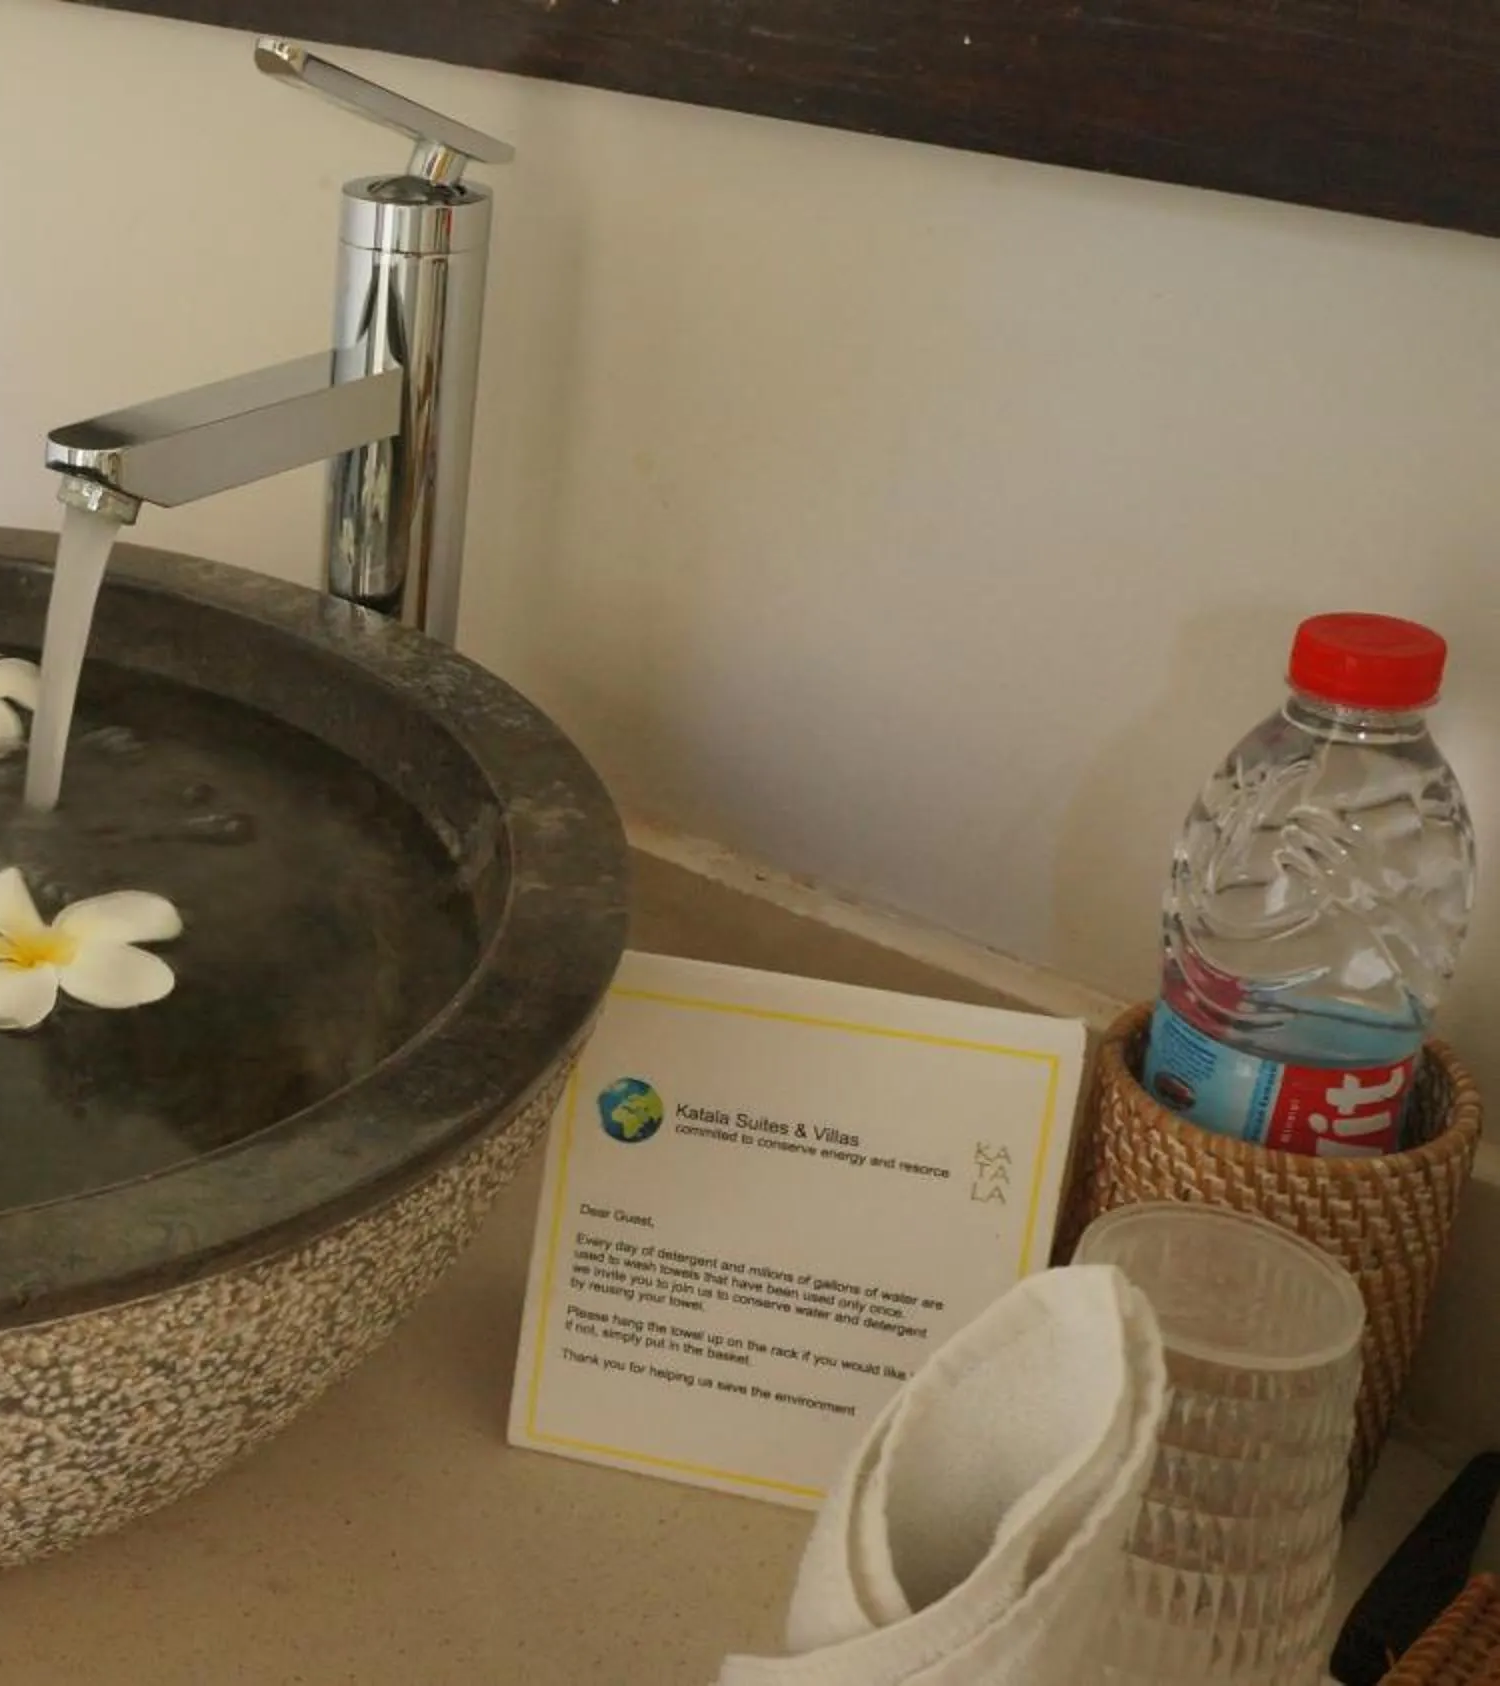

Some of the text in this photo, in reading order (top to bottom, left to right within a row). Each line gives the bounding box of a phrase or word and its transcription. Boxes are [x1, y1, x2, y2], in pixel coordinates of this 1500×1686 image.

[675, 1103, 860, 1147] Katala Suites & Villas
[741, 1133, 753, 1145] to
[757, 1137, 817, 1156] conserve
[820, 1147, 867, 1166] energy
[870, 1156, 896, 1169] and
[580, 1203, 611, 1219] Dear
[570, 1277, 586, 1290] by
[588, 1281, 635, 1300] reusing
[638, 1292, 666, 1303] your
[574, 1250, 605, 1263] used
[608, 1255, 620, 1265] to
[624, 1257, 657, 1272] wash
[659, 1264, 701, 1281] towels
[704, 1271, 728, 1285] that
[731, 1276, 763, 1292] have
[767, 1282, 799, 1300] been
[803, 1291, 835, 1305] used
[838, 1298, 866, 1313] only
[576, 1232, 612, 1250] Every
[616, 1241, 638, 1256] day
[641, 1246, 655, 1256] of
[657, 1248, 717, 1268] detergent
[721, 1261, 745, 1273] and
[797, 1274, 811, 1285] of
[864, 1287, 879, 1297] of
[881, 1291, 918, 1305] water
[921, 1299, 944, 1311] are
[572, 1264, 927, 1338] we invite you to join us to conserve water and detergent
[567, 1304, 609, 1322] Please
[612, 1312, 644, 1332] hang
[647, 1321, 667, 1334] the
[671, 1325, 704, 1340] towel
[707, 1333, 725, 1346] up
[727, 1338, 743, 1349] on
[747, 1340, 767, 1353] the
[770, 1346, 799, 1359] rack
[802, 1350, 811, 1362] if
[813, 1355, 838, 1368] you
[841, 1359, 881, 1376] would
[883, 1365, 906, 1381] like
[602, 1328, 643, 1347] simply
[645, 1337, 665, 1349] put
[669, 1341, 680, 1352] in
[683, 1343, 703, 1356] the
[562, 1346, 856, 1417] Thank you for helping us save the environment
